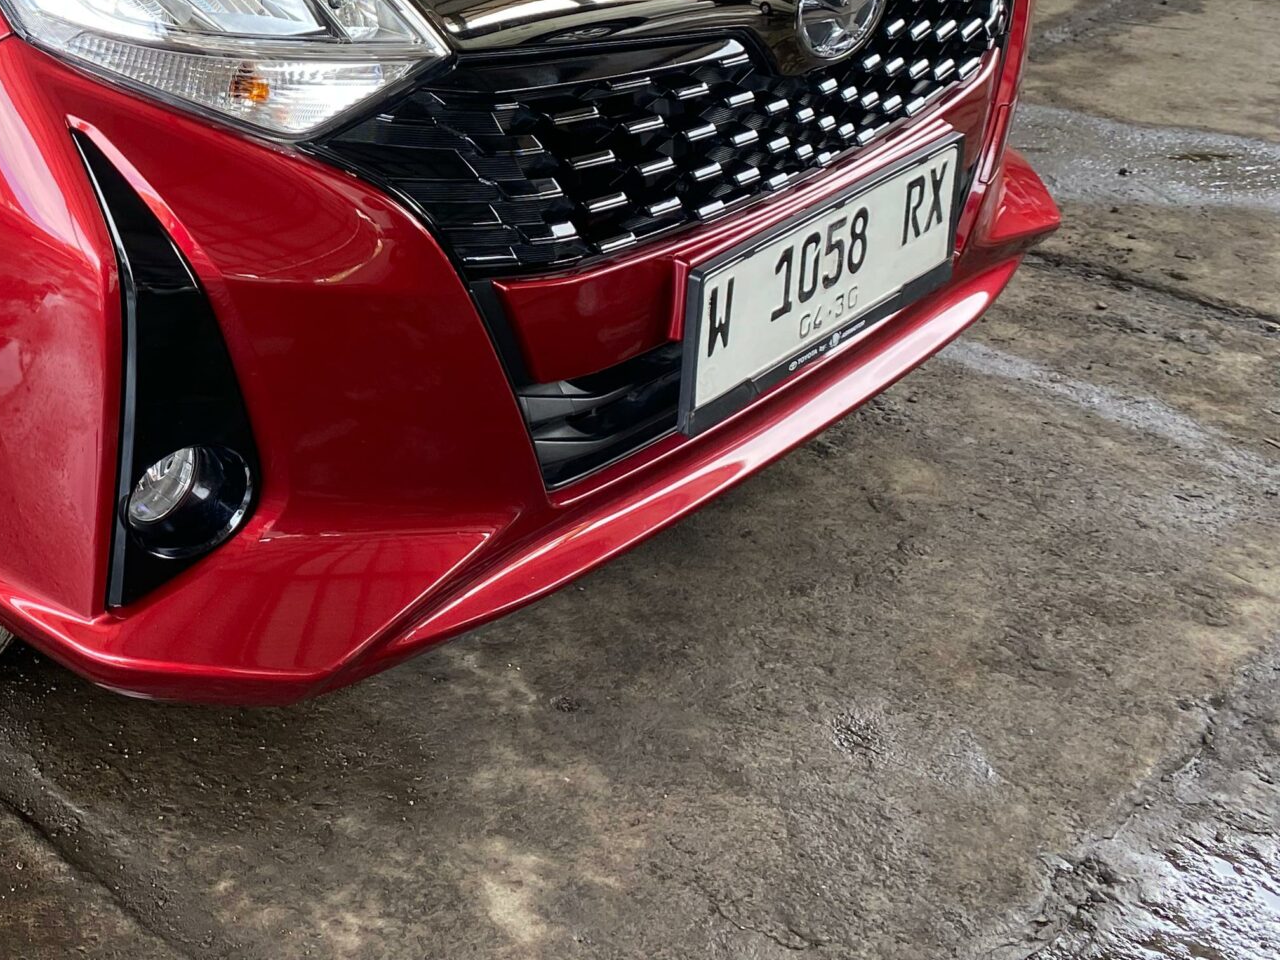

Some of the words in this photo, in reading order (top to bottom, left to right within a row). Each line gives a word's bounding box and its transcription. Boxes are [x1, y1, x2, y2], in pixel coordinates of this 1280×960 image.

[707, 277, 735, 358] W
[770, 206, 868, 323] 1058
[901, 159, 948, 248] RX
[797, 348, 818, 365] TOYOTA
